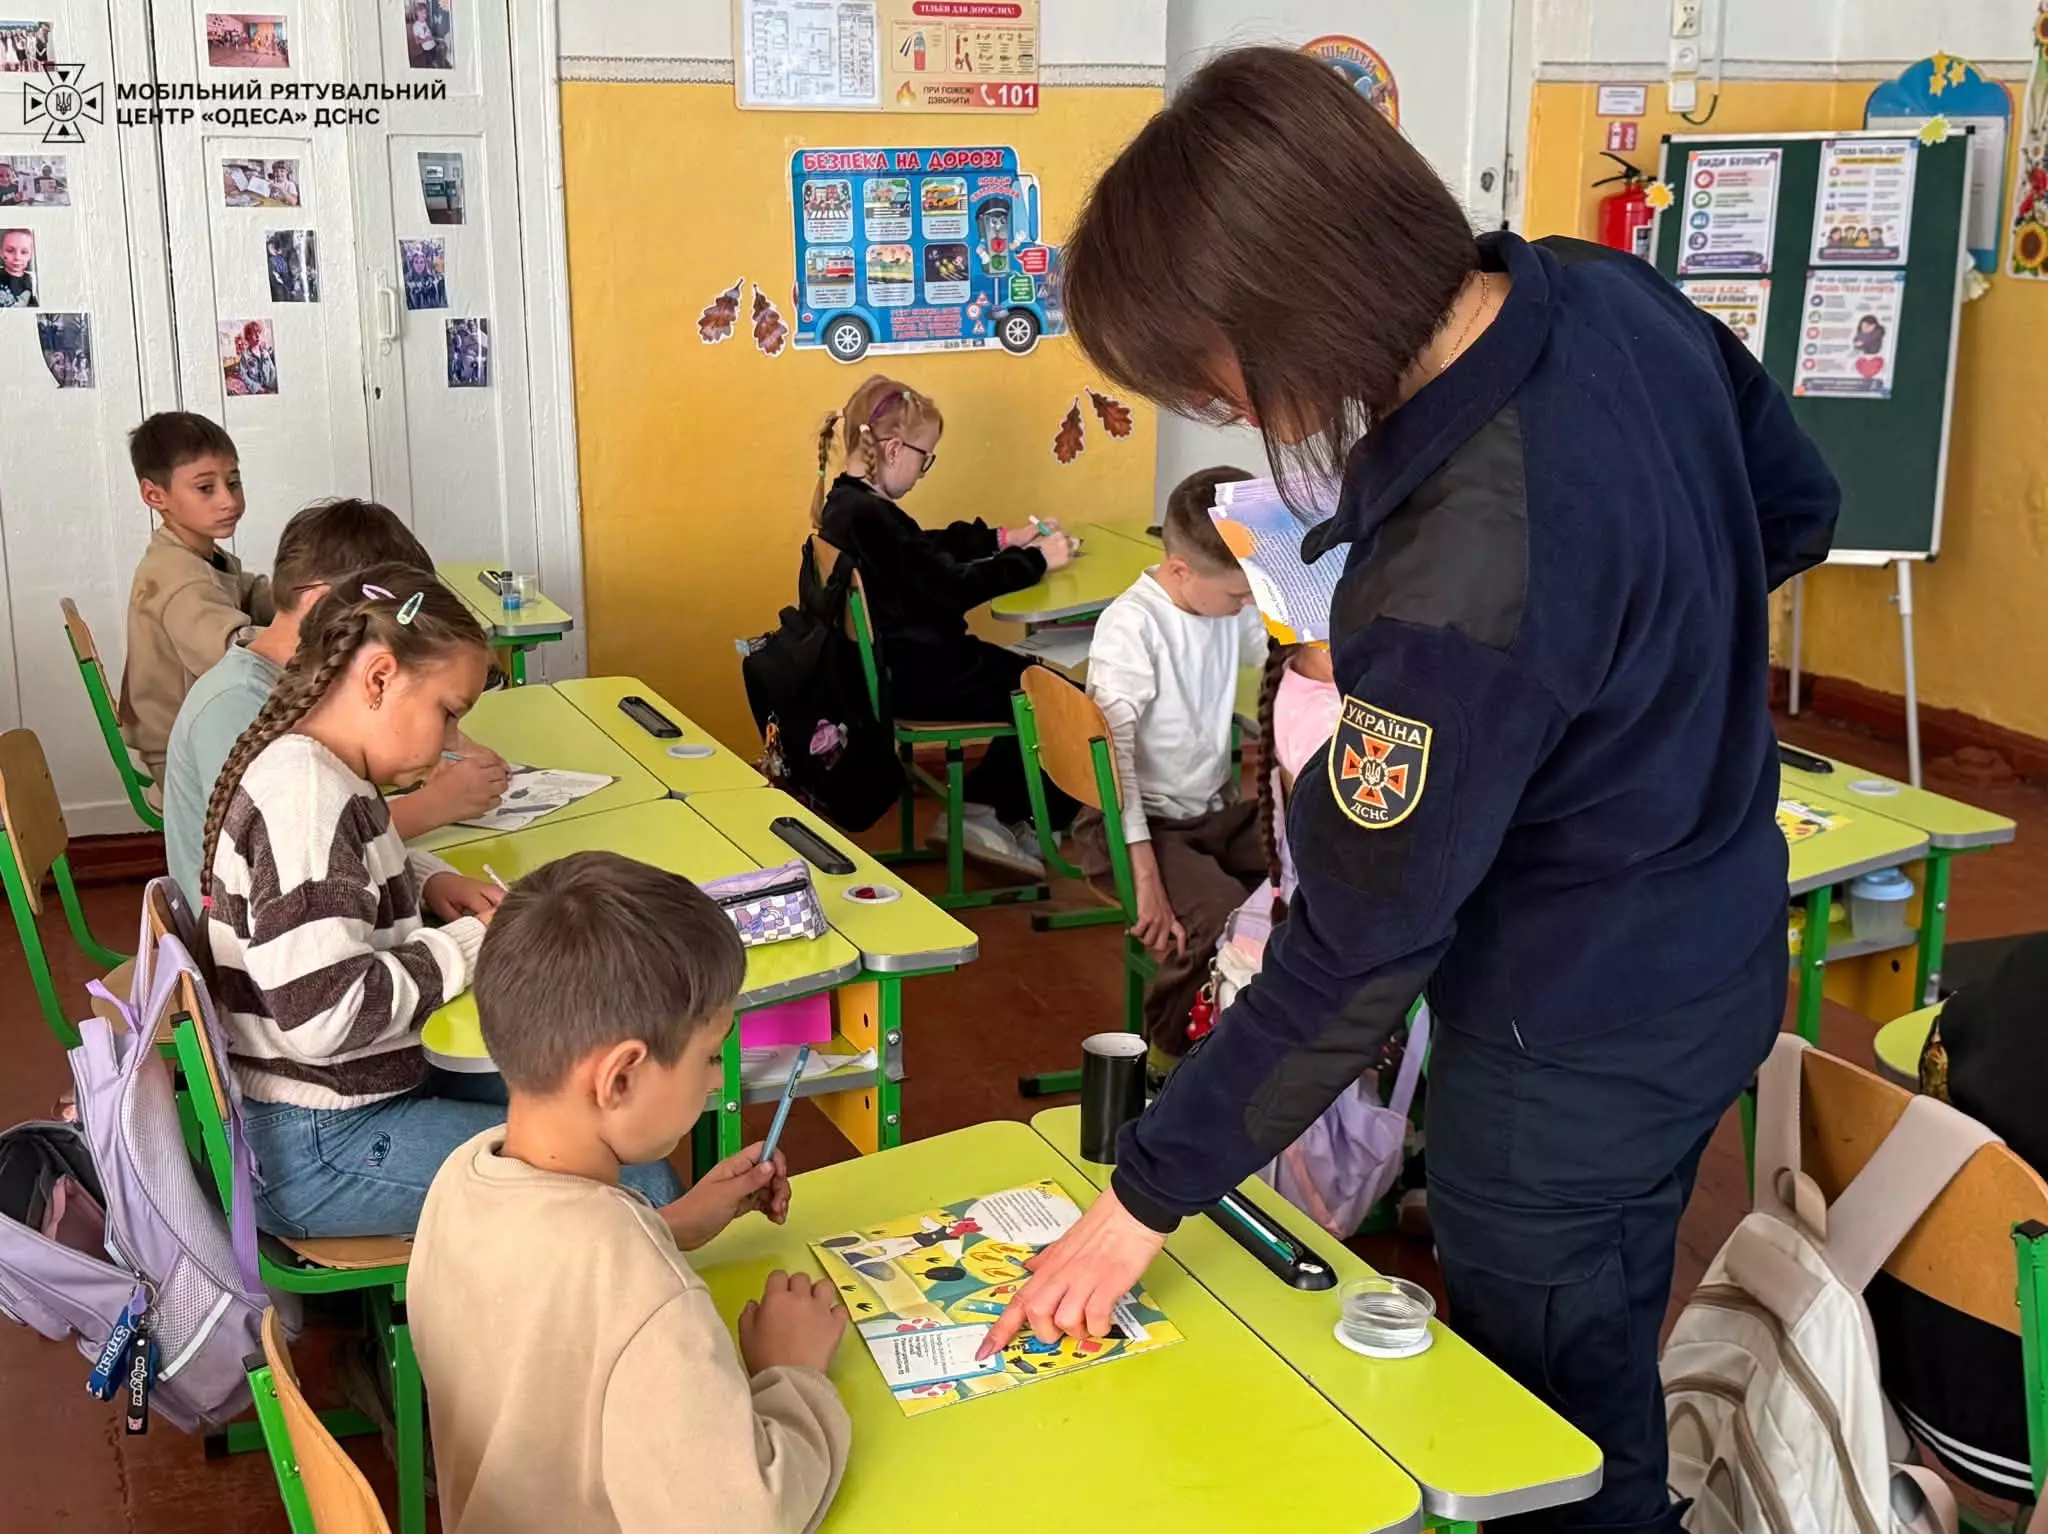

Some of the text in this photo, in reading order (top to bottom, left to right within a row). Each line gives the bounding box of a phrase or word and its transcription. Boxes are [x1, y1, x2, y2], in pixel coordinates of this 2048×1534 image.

[923, 86, 940, 94] ПРИ
[998, 84, 1035, 106] 101
[927, 95, 970, 105] ДЗВОНИТИ
[804, 150, 1004, 171] БЕЗПЕКА НА ДОРОЗІ
[1345, 703, 1422, 745] УКРАЇНА
[1350, 802, 1389, 820] ДСНС
